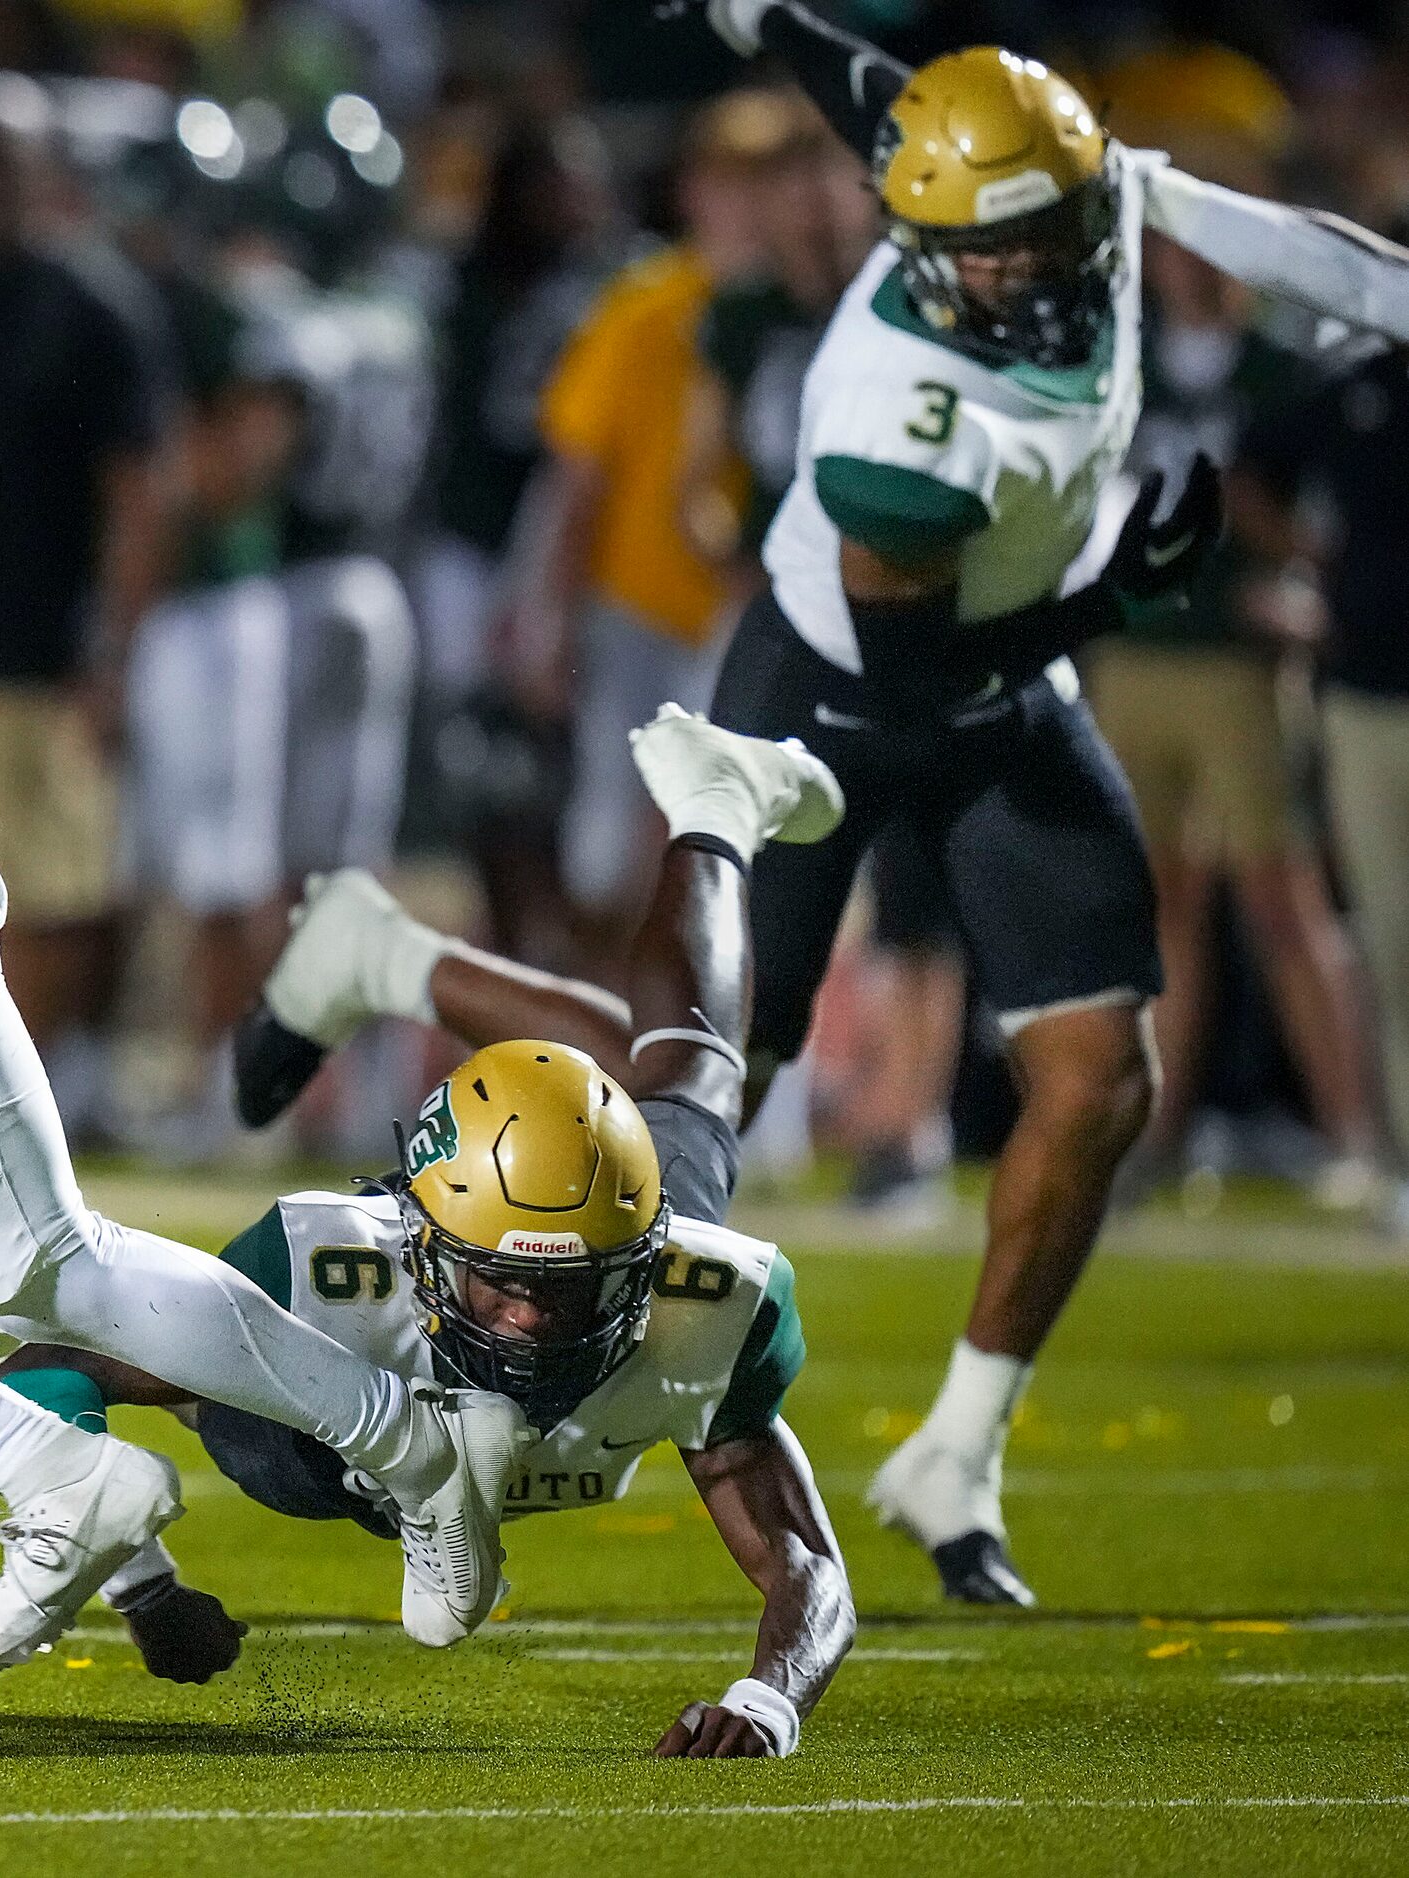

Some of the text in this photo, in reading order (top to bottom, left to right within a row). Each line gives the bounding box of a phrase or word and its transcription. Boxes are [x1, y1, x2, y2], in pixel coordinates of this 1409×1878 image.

[904, 378, 960, 445] 3
[309, 1245, 398, 1306] 6
[651, 1243, 739, 1302] 6
